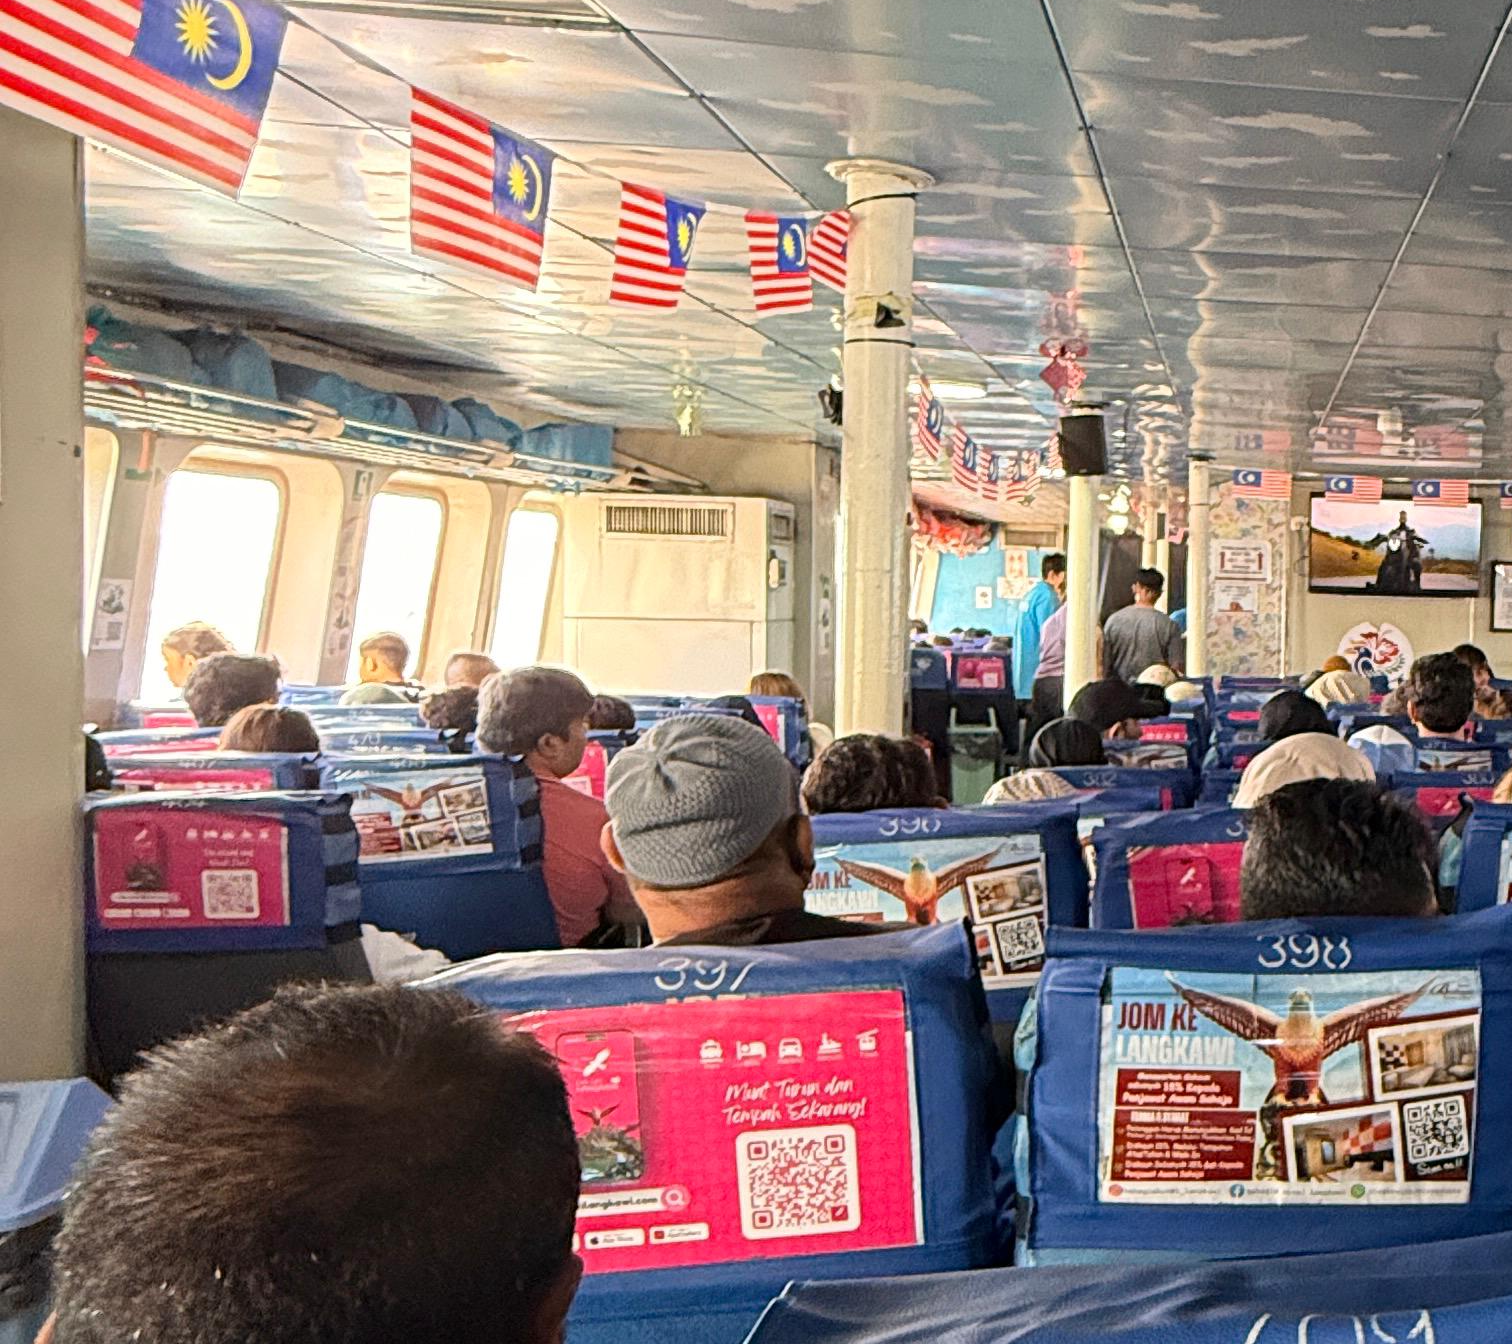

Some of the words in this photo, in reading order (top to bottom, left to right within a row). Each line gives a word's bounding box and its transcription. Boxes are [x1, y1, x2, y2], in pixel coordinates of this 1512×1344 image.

[1256, 933, 1352, 969] 398
[1117, 1002, 1165, 1030] JOM
[1170, 1002, 1198, 1032] KE
[1116, 1033, 1236, 1065] LANGKAWI
[725, 1082, 770, 1103] Muat
[774, 1078, 821, 1098] Turun
[824, 1075, 854, 1094] dan
[722, 1102, 782, 1127] Tempah
